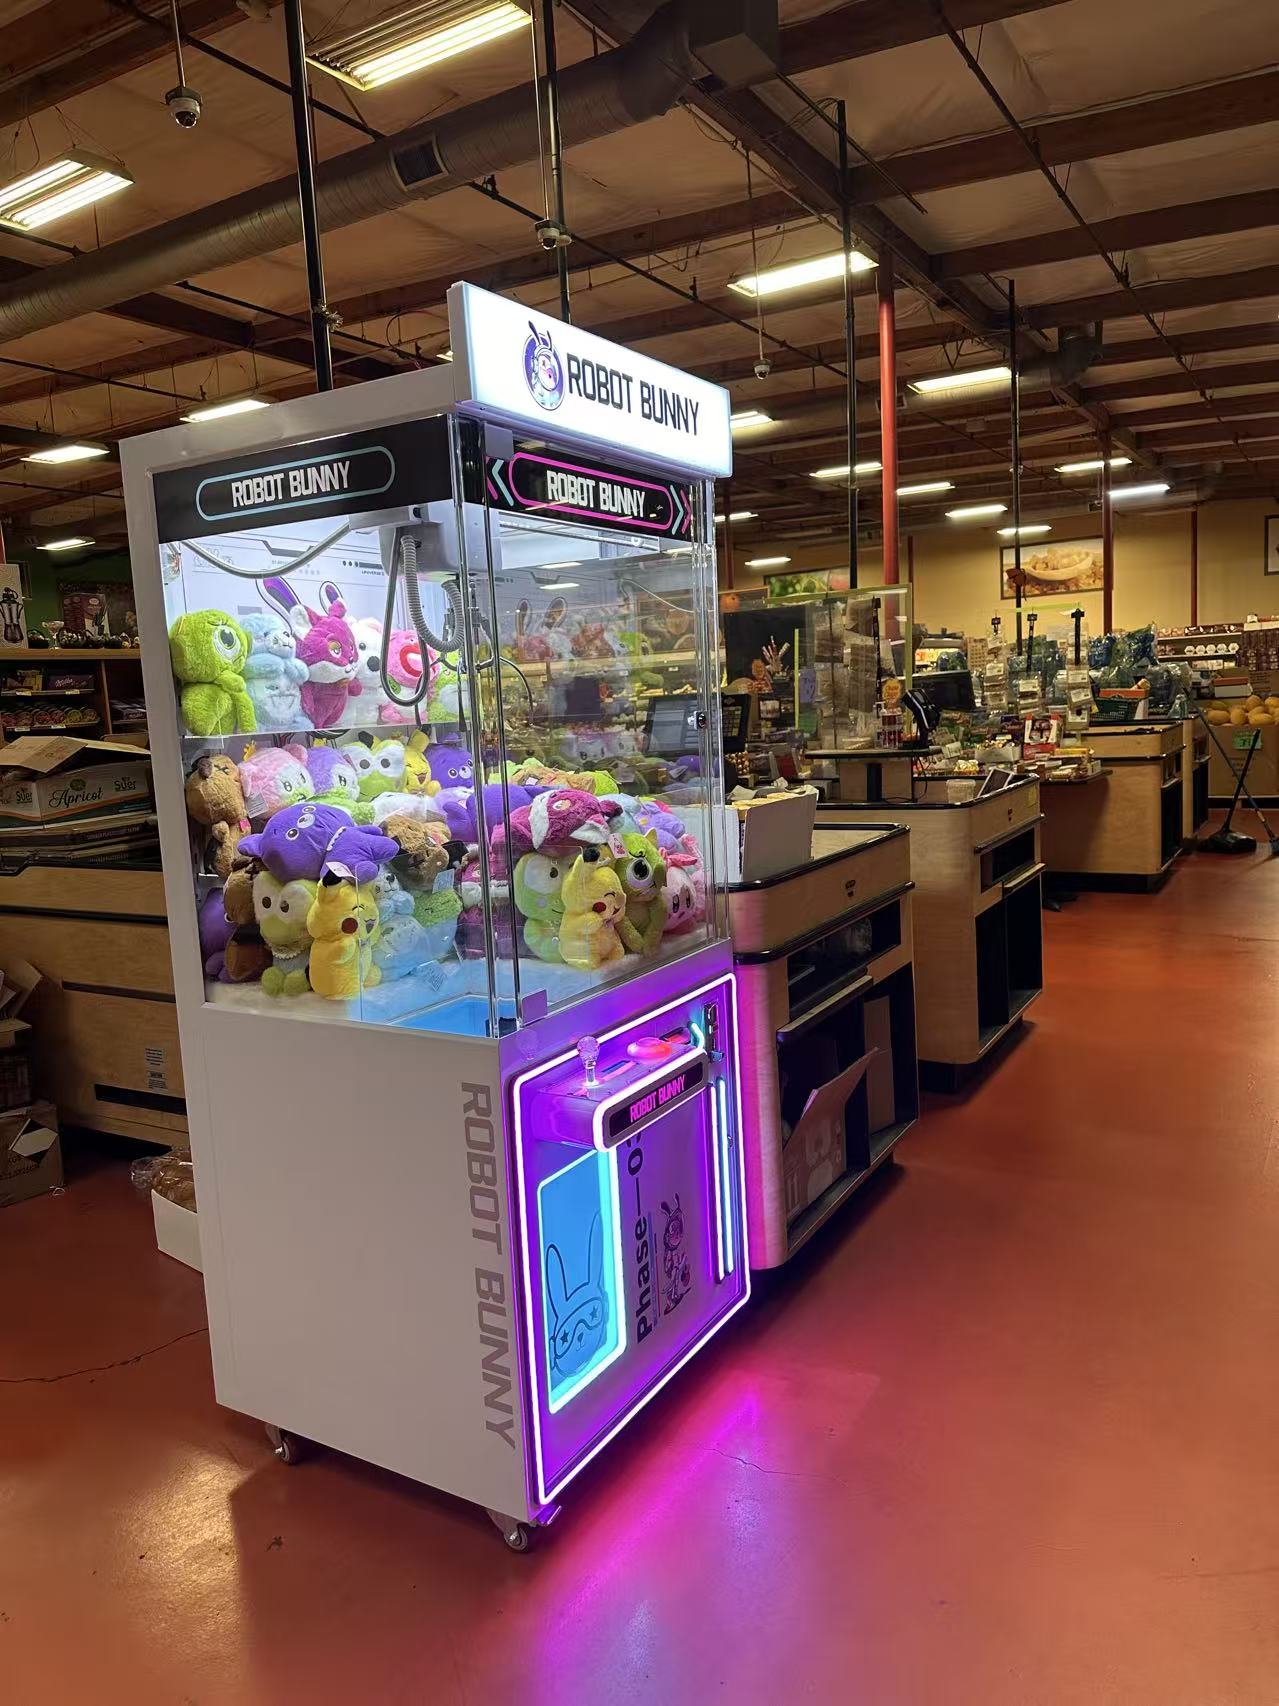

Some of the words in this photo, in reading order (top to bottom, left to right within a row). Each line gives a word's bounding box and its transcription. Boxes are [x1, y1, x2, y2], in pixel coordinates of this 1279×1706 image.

[566, 353, 634, 412] ROBOT
[640, 380, 699, 435] BUNNY
[231, 472, 284, 507] ROBOT
[290, 460, 350, 495] BUNNY
[546, 471, 594, 507] ROBOT
[599, 483, 646, 518] BUNNY
[49, 787, 103, 808] Apricot
[629, 1091, 656, 1122] ROBOT
[658, 1074, 686, 1105] BUNNY
[461, 1081, 503, 1256] ROBOT
[475, 1267, 517, 1450] BUNNY
